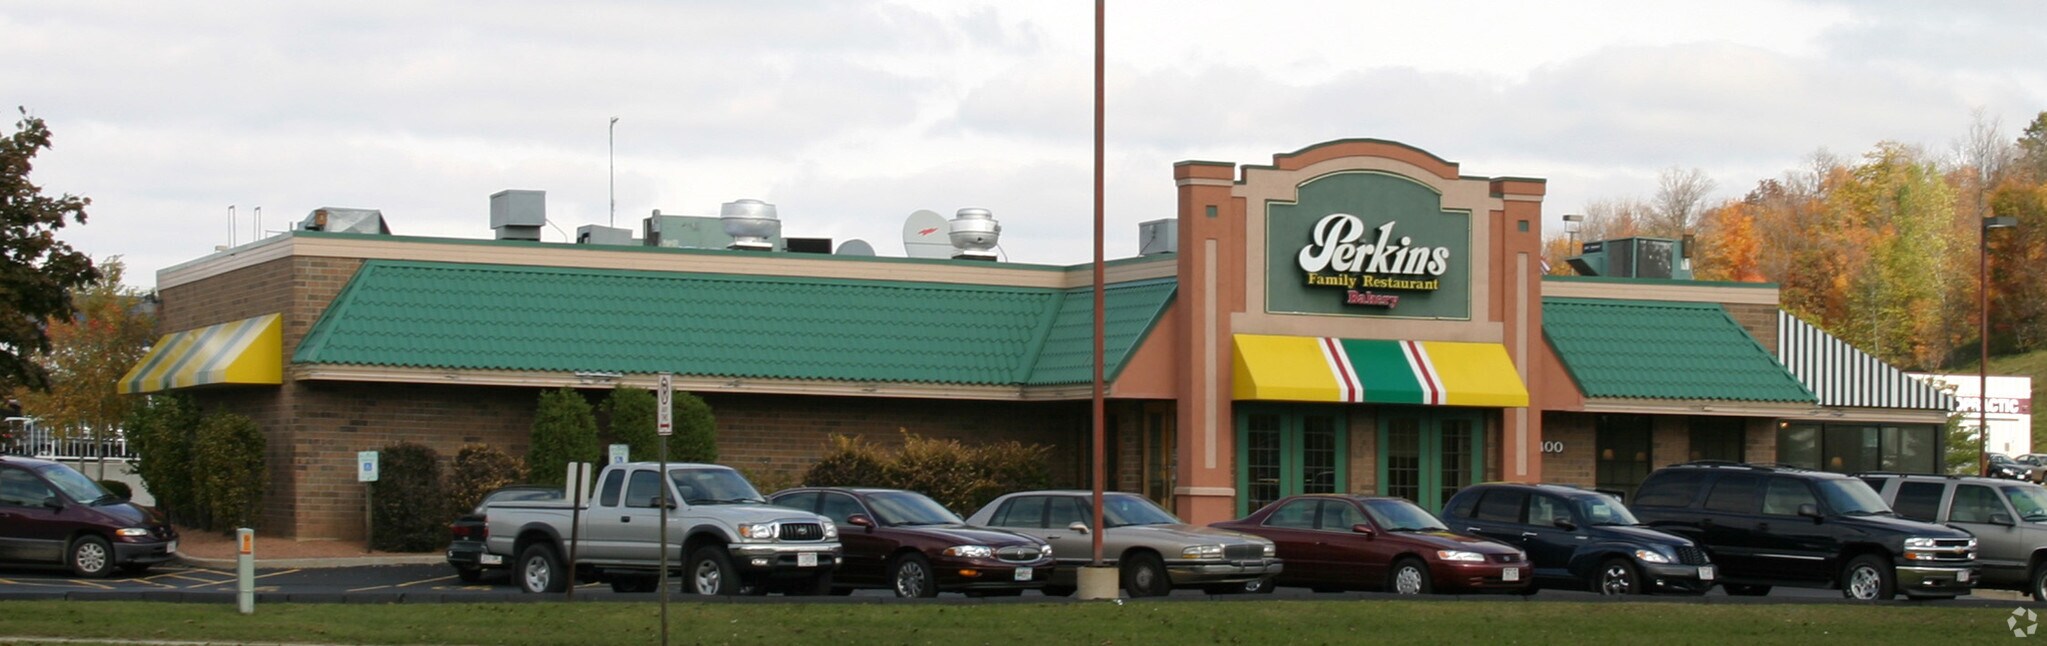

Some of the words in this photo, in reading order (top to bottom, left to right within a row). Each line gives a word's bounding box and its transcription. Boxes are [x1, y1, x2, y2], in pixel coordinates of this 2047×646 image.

[1299, 213, 1450, 276] Perkins
[1308, 273, 1357, 288] Family
[1363, 275, 1439, 290] Restaurant
[1347, 290, 1399, 308] Bakery
